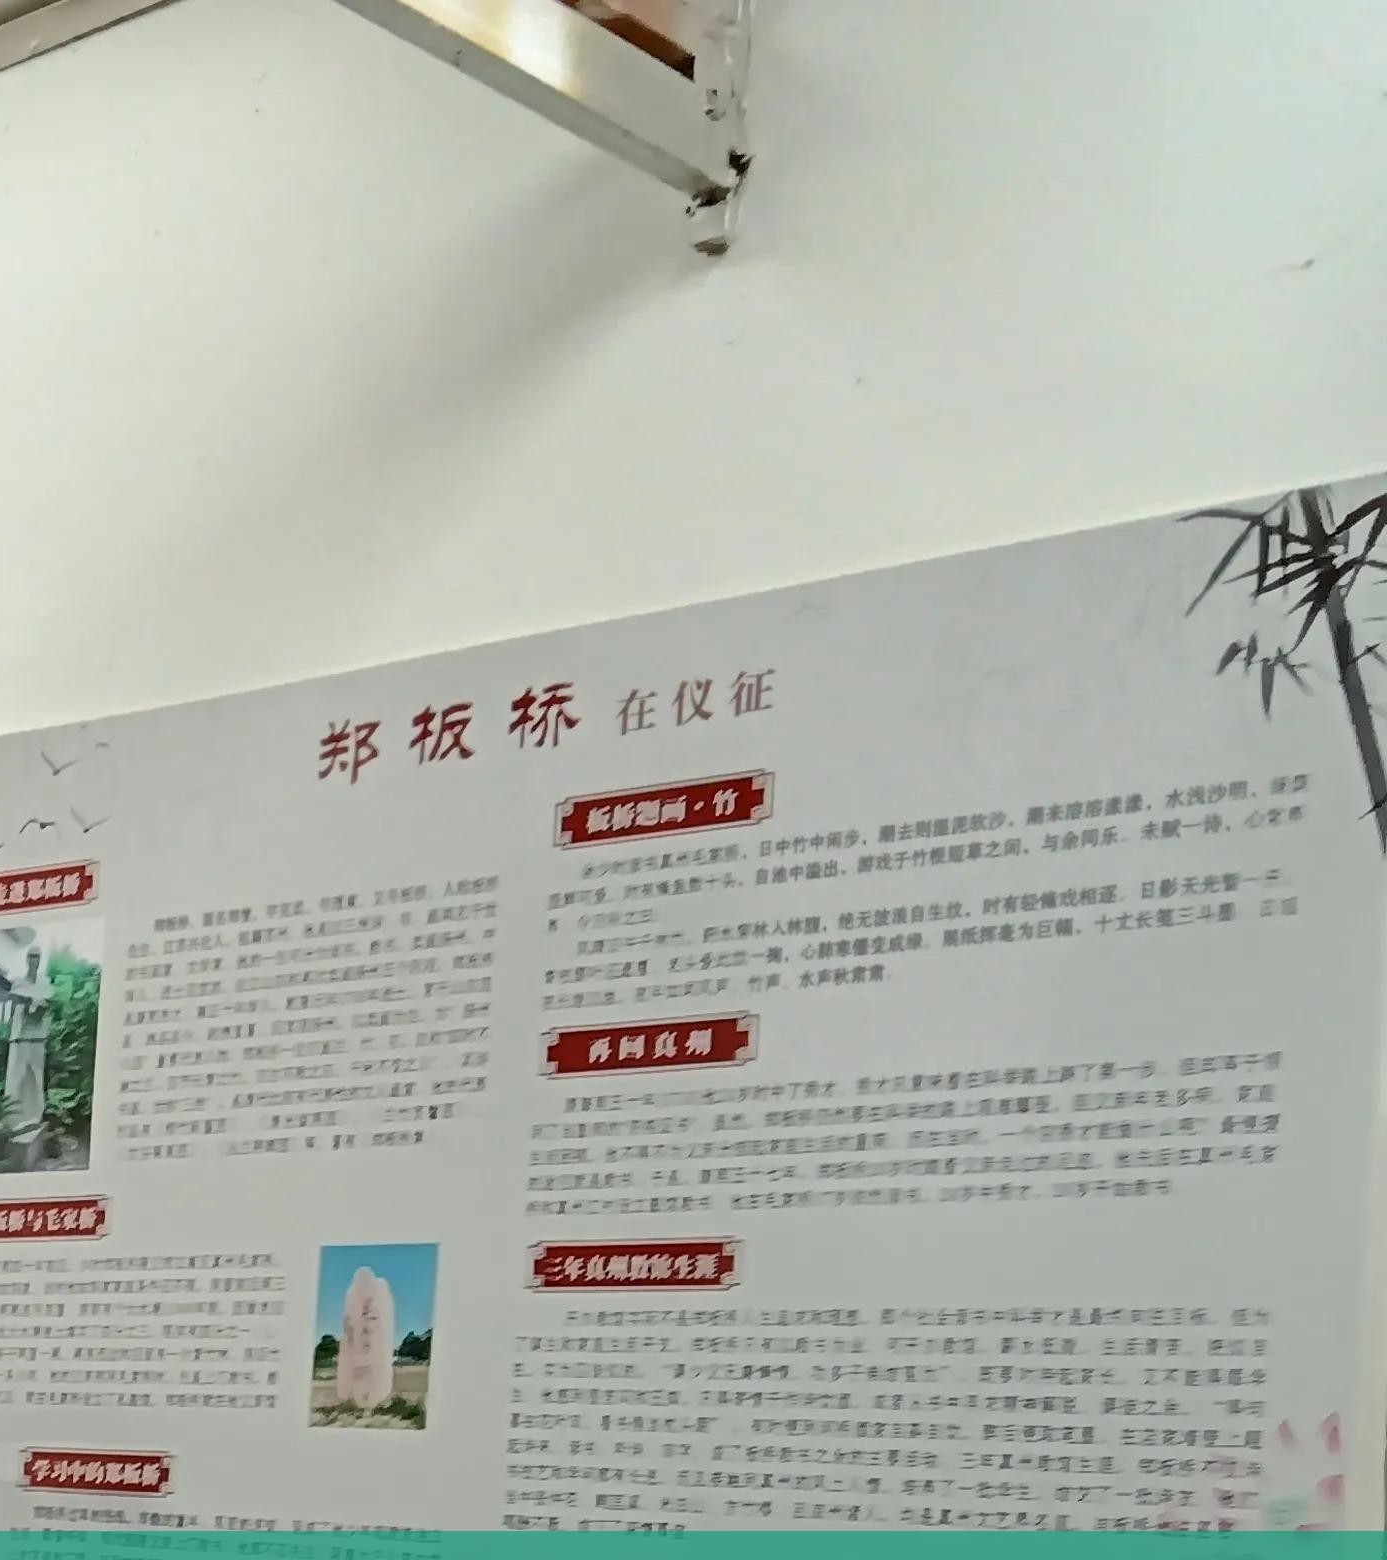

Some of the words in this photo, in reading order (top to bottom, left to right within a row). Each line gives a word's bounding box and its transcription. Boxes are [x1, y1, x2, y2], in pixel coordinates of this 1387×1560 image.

[318, 681, 581, 785] 郑板桥
[616, 667, 776, 736] 在仪征
